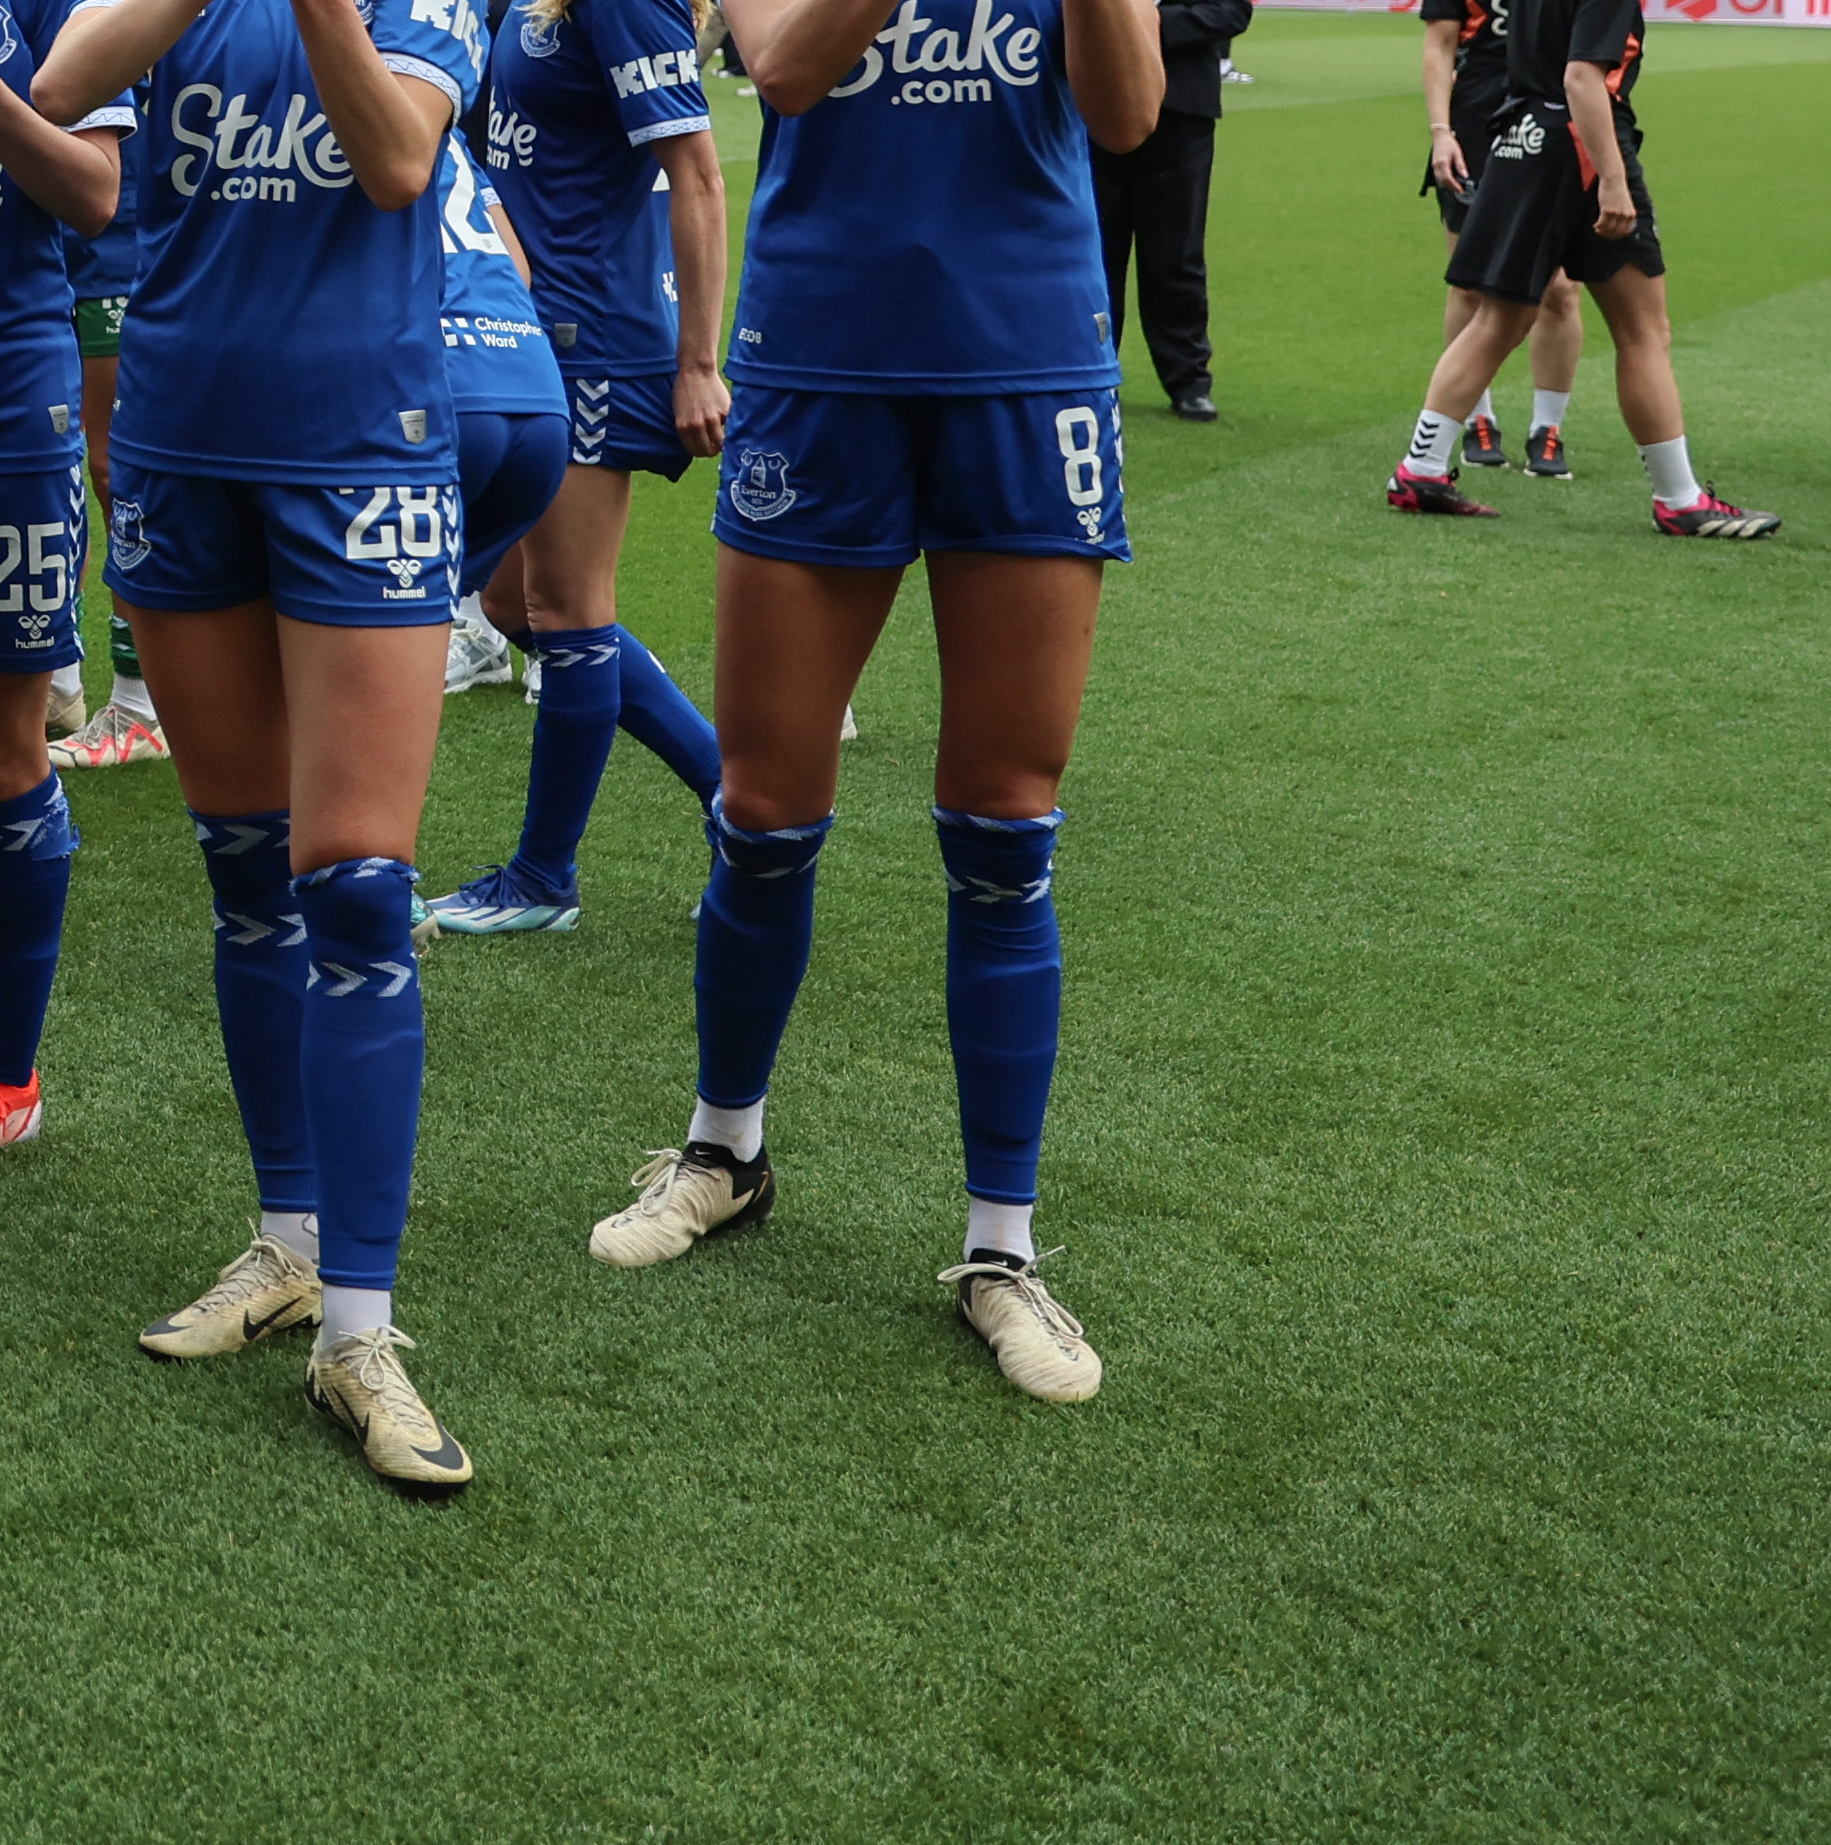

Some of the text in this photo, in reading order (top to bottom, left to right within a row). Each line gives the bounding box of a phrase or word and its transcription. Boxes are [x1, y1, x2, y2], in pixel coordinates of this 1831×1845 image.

[609, 48, 699, 99] KICK
[890, 78, 992, 105] .com
[488, 85, 537, 167] take
[211, 176, 296, 202] .com
[475, 317, 542, 337] Christopher
[480, 333, 518, 349] Ward
[1055, 405, 1103, 506] 8
[740, 484, 777, 499] Everton
[339, 486, 440, 559] 28
[383, 585, 427, 600] hummel
[15, 635, 55, 650] hummel
